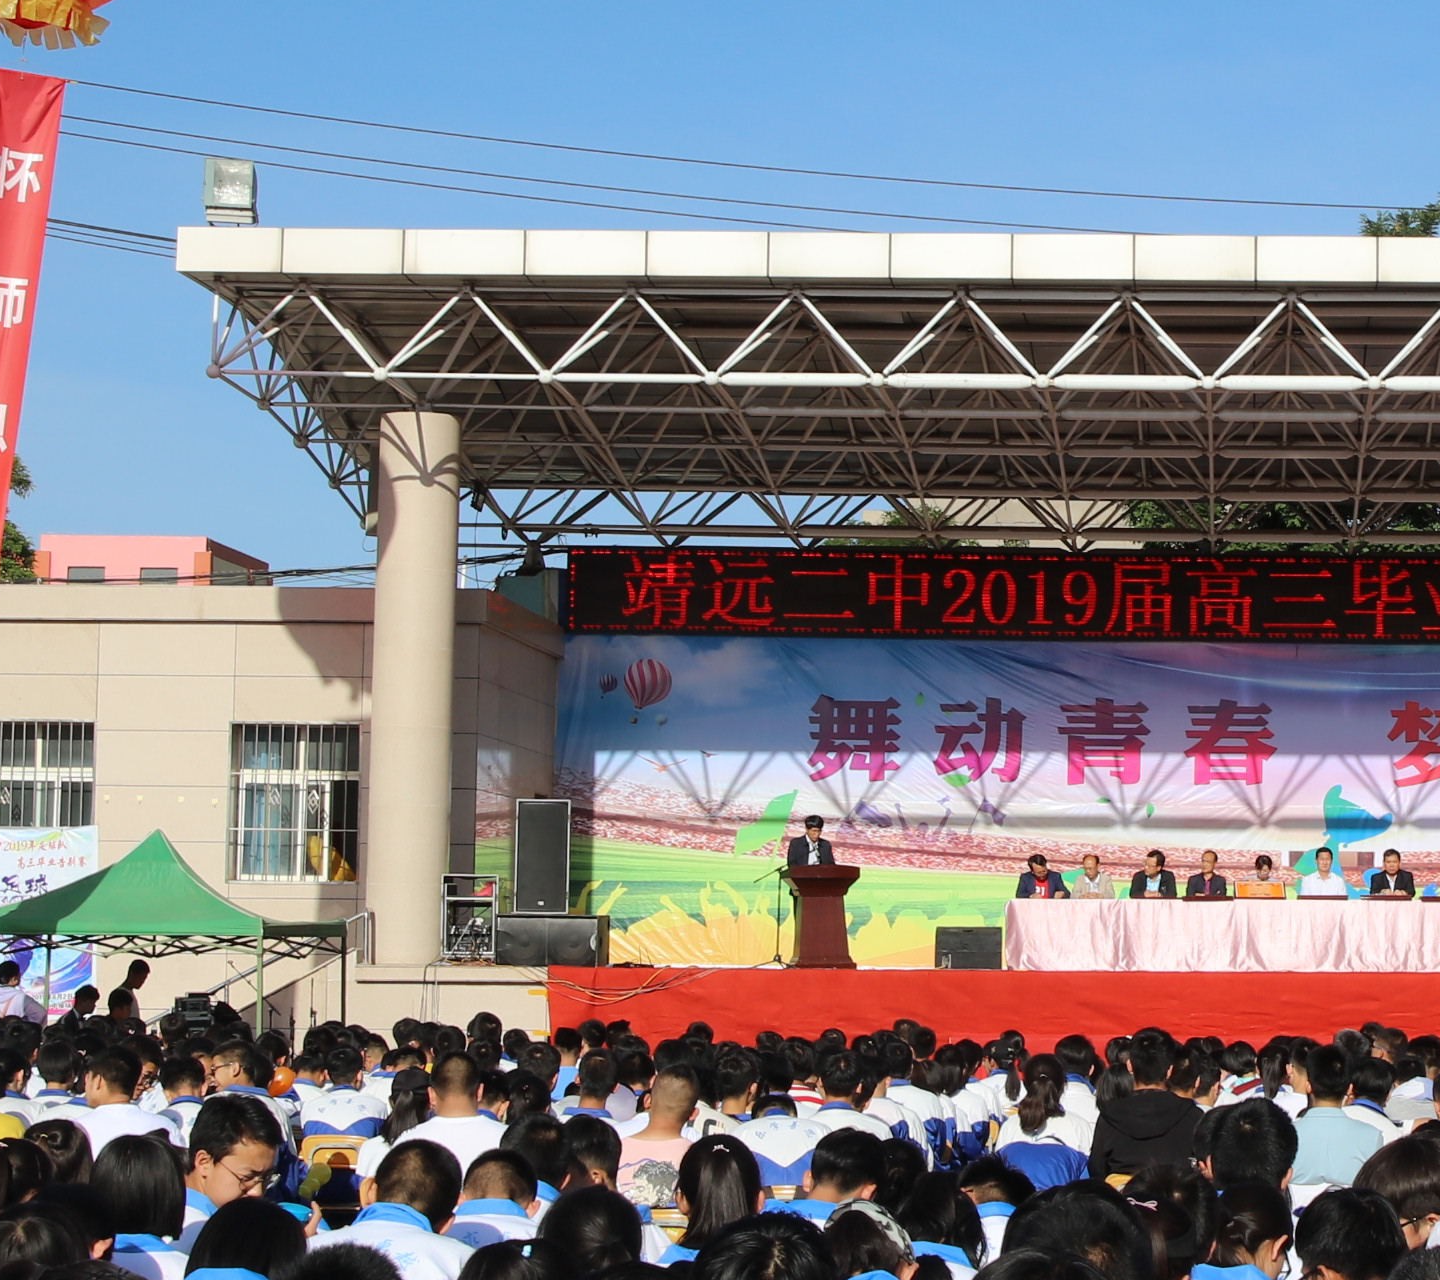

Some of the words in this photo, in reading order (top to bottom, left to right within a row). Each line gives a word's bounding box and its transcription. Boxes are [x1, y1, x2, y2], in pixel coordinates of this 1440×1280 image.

[807, 694, 1277, 786] 舞动青春
[0, 874, 49, 894] 足球
